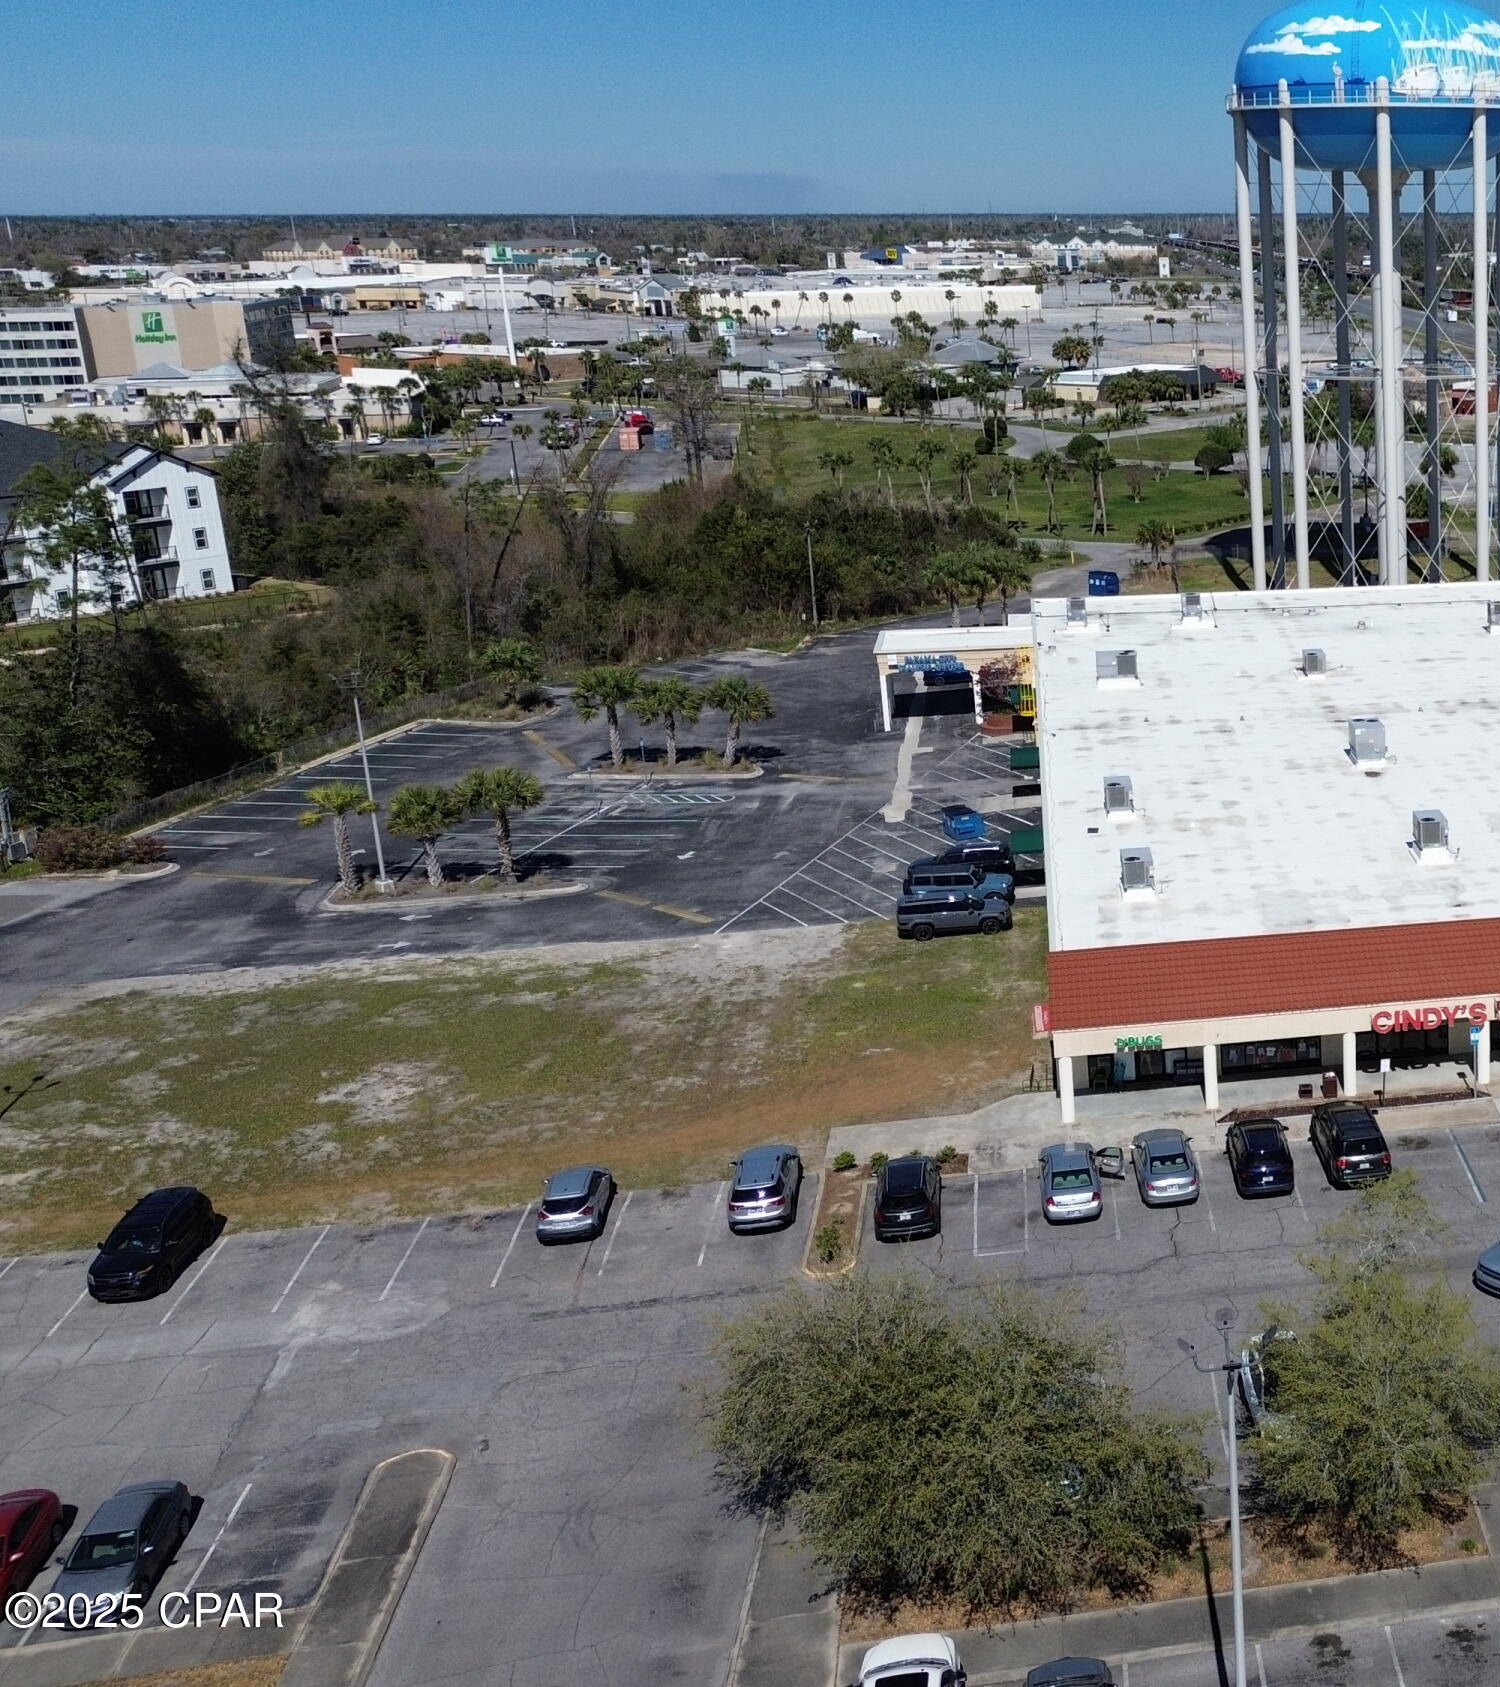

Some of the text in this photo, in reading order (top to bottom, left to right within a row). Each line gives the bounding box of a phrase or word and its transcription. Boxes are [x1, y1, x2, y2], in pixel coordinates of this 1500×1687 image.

[135, 333, 176, 344] Holiday Inn
[1372, 1003, 1488, 1034] CINDY'S
